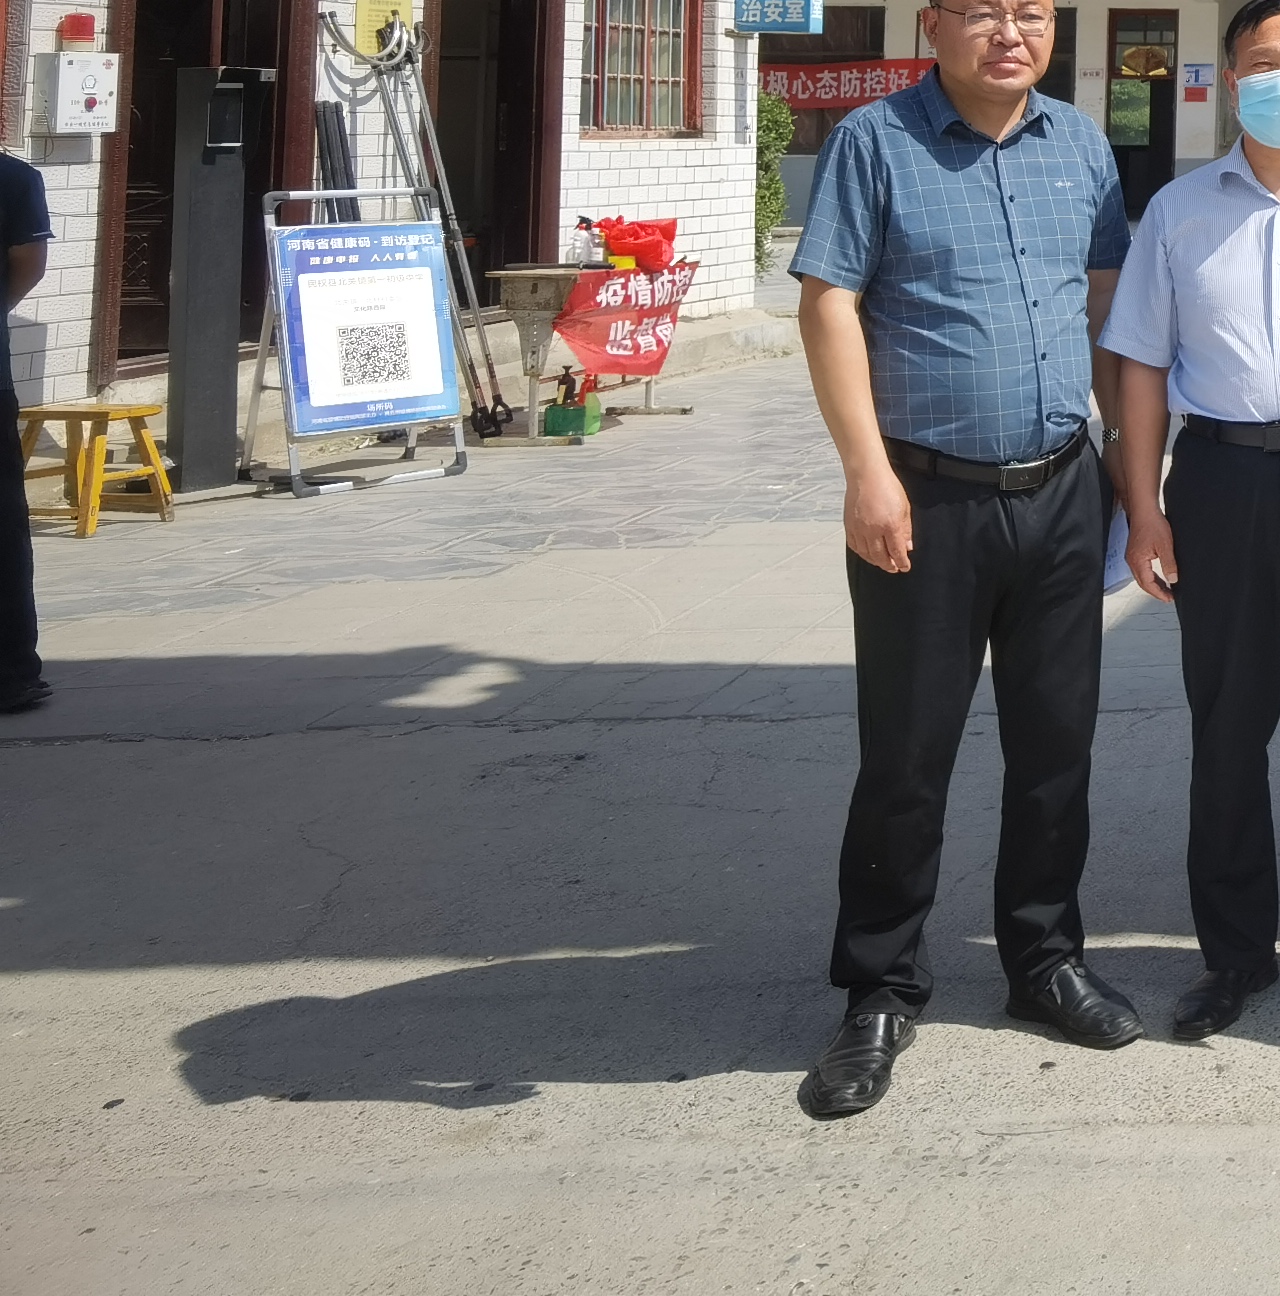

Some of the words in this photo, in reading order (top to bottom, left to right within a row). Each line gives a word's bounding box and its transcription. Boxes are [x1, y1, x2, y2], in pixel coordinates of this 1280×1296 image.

[758, 68, 912, 100] 极心态防控好
[596, 266, 693, 310] 疫情防控
